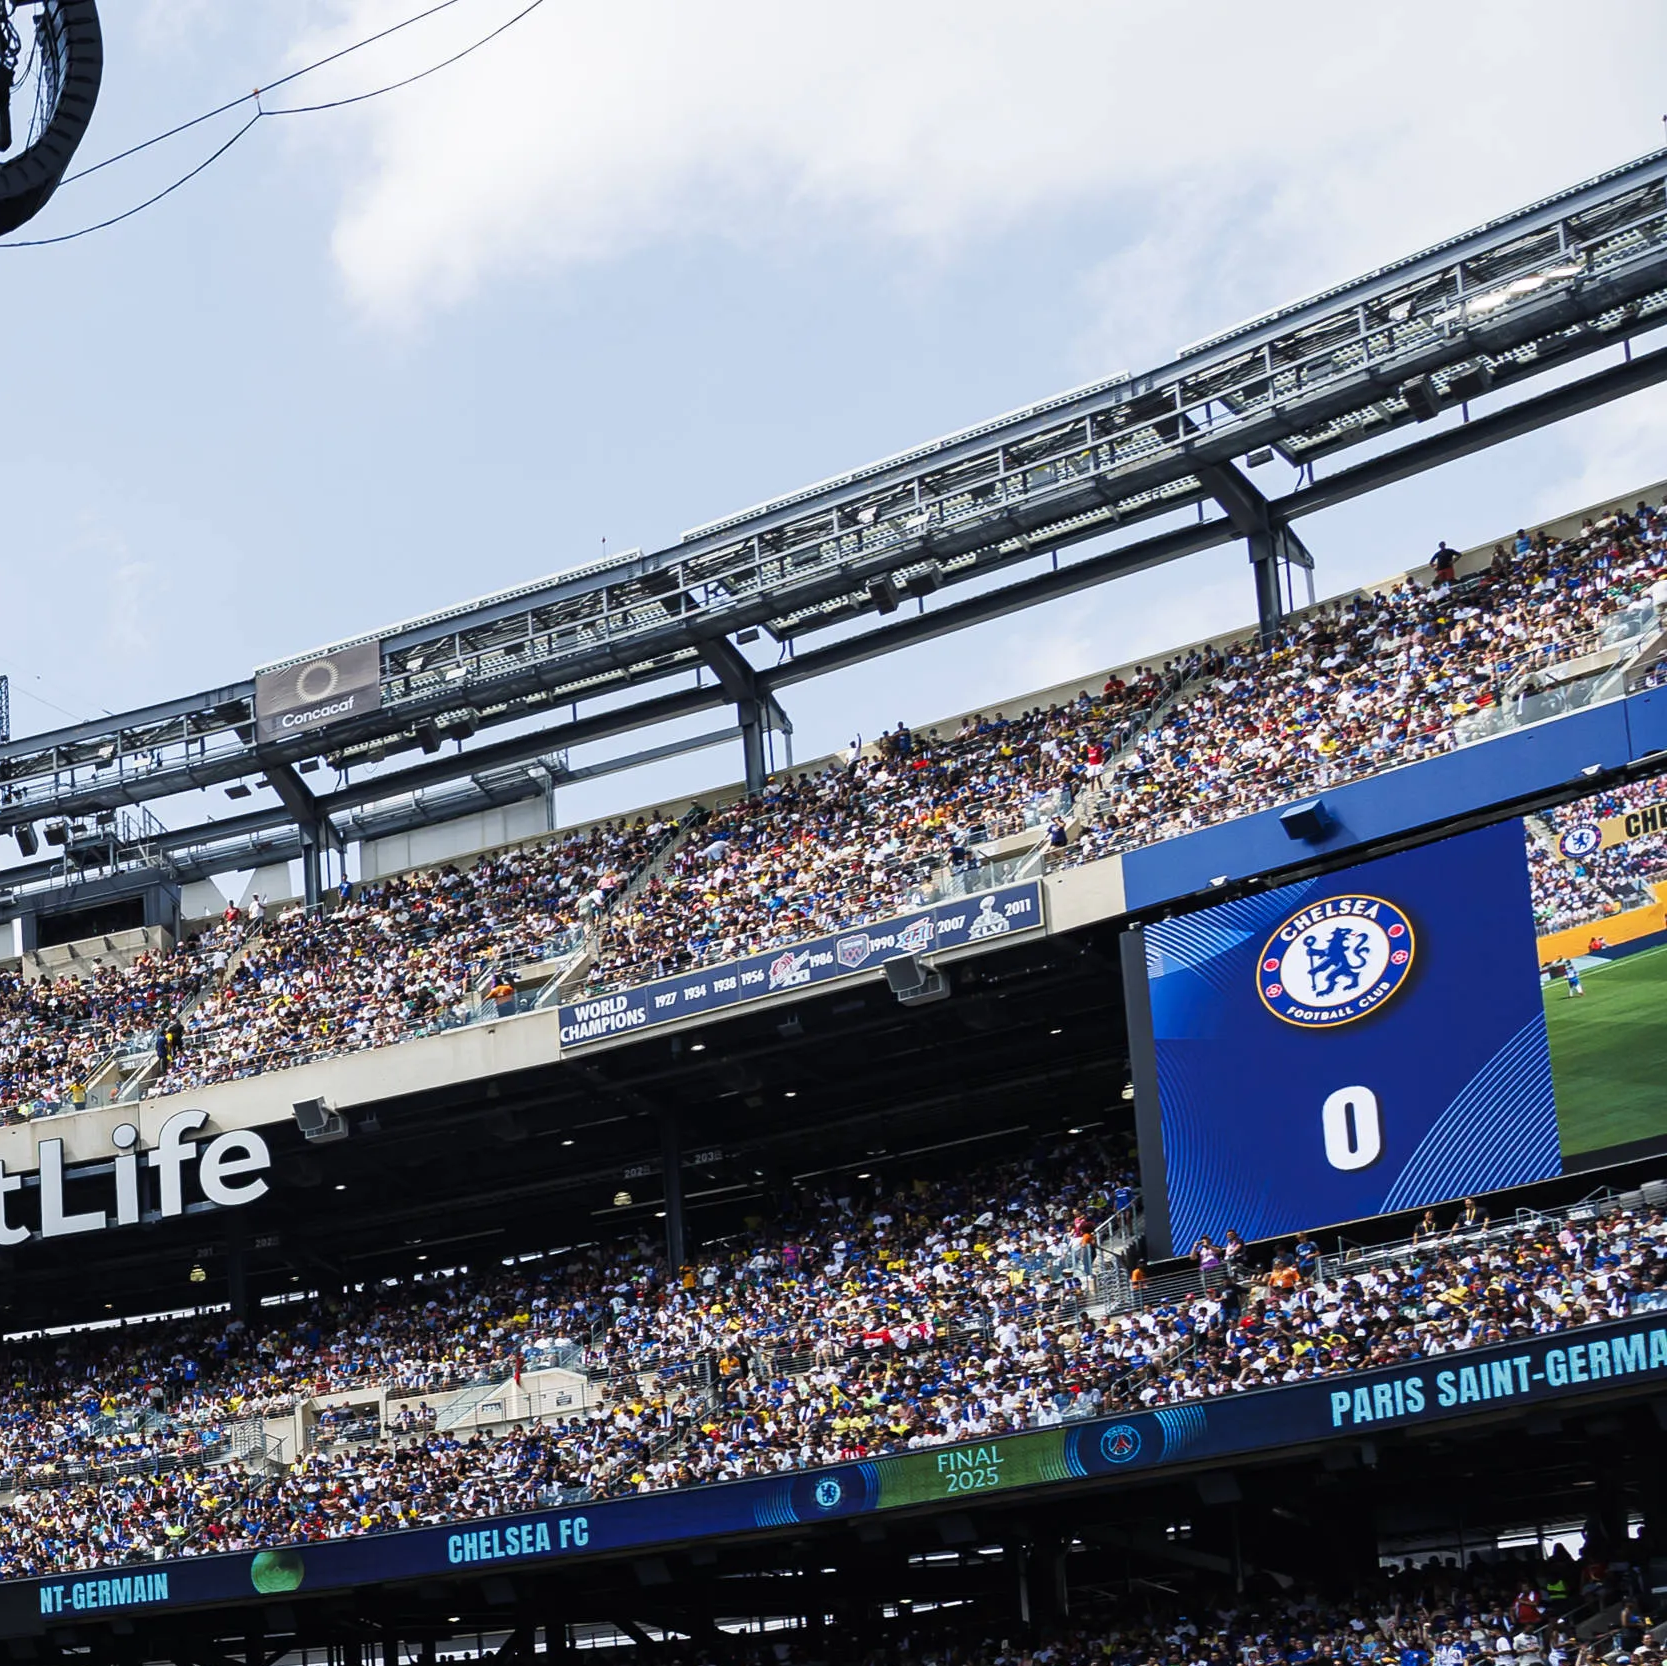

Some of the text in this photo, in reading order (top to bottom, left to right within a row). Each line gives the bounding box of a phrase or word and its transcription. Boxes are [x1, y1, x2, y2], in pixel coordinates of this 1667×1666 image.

[282, 695, 355, 728] Concacaf
[1004, 898, 1031, 918] 2011
[1280, 899, 1380, 942] CHELSEA
[936, 915, 966, 934] 2007
[870, 934, 895, 952] 1990
[809, 951, 834, 968] 1986
[741, 969, 765, 986] 1956
[654, 976, 737, 1009] 1927 1934 1938
[1359, 982, 1391, 1008] CLUB
[574, 996, 628, 1022] WORLD
[1286, 1005, 1355, 1021] FOOTBALL
[560, 1007, 646, 1043] CHAMPIONS
[1322, 1085, 1381, 1170] 0
[1331, 1377, 1425, 1427] PARIS
[937, 1446, 1004, 1472] FINAL
[944, 1466, 1000, 1494] 2025
[448, 1517, 590, 1565] CHELSEA FC
[40, 1573, 169, 1614] NT-GERMAIN
